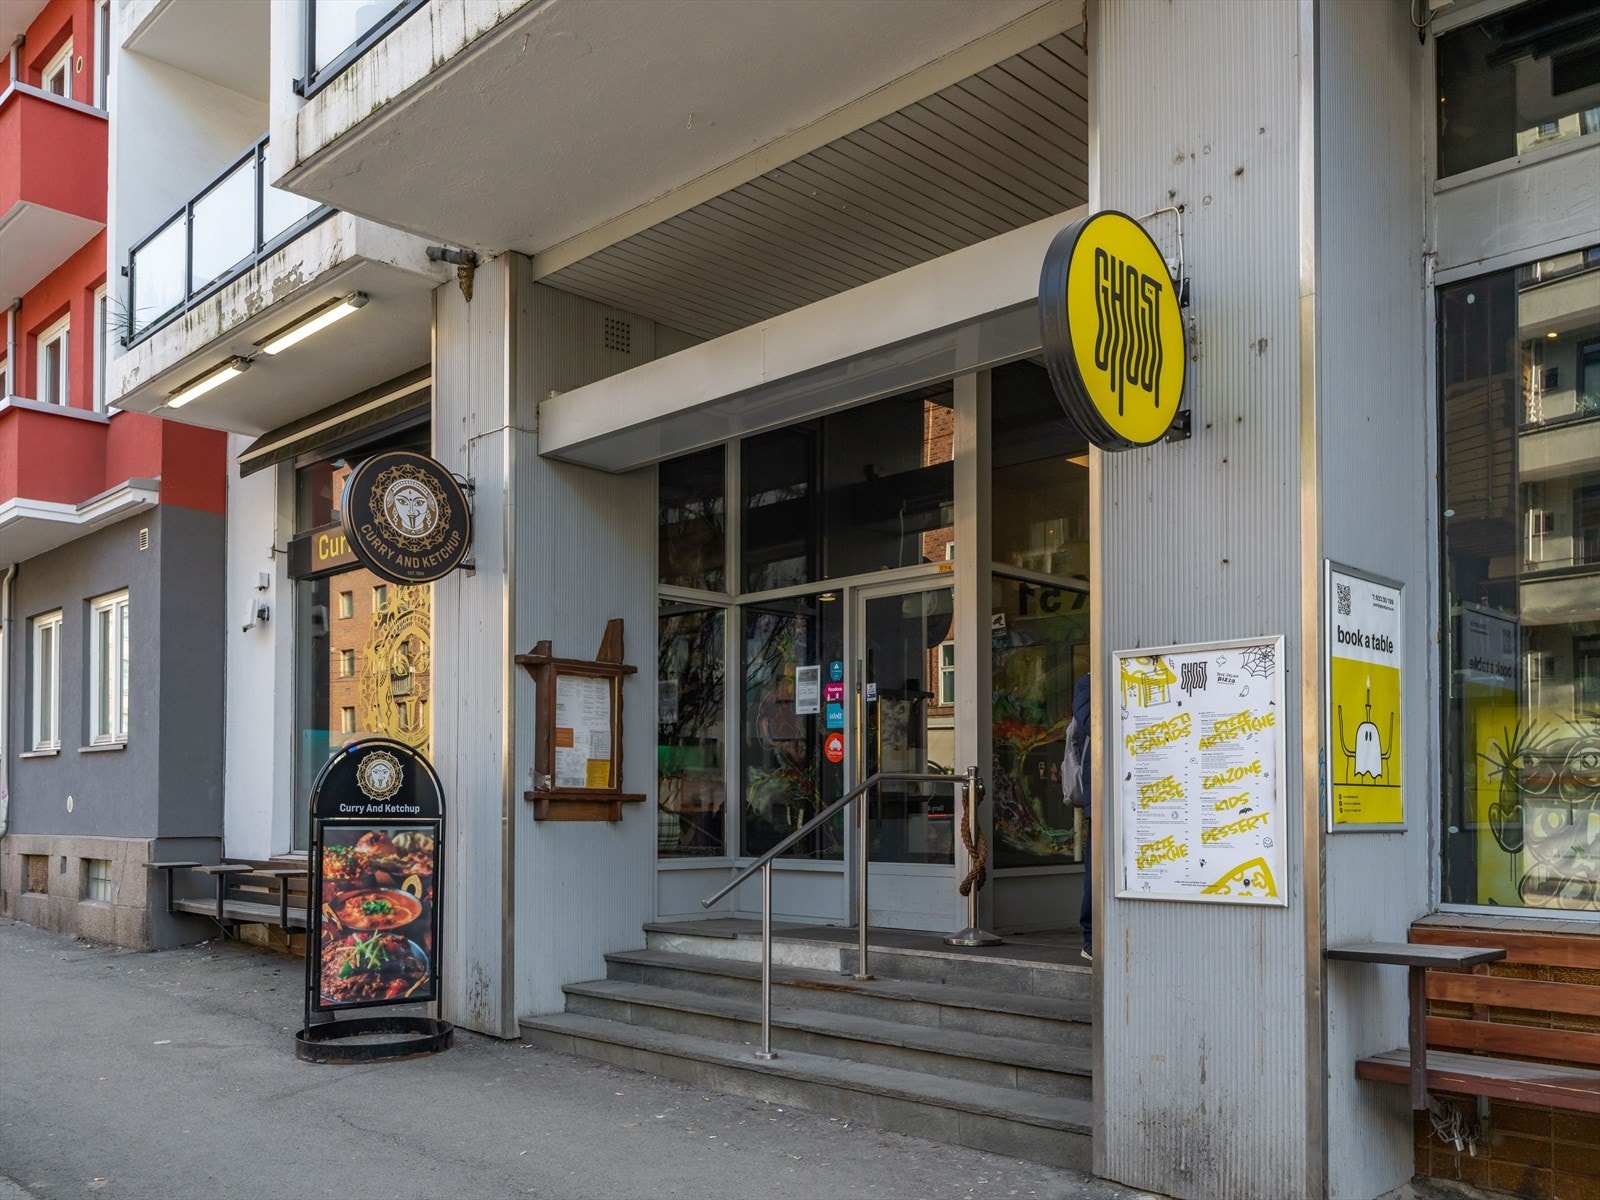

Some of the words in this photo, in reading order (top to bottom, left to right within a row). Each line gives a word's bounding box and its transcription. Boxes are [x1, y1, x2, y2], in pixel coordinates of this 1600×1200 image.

[1094, 247, 1163, 416] GHOST
[319, 534, 351, 560] Cur
[361, 524, 395, 560] CURRY
[395, 554, 420, 568] AND
[422, 530, 461, 568] KETCHUP
[1337, 625, 1363, 648] book
[1365, 635, 1371, 648] a
[1371, 634, 1393, 653] table
[1181, 661, 1208, 697] GHOST
[1203, 760, 1262, 790] CALZONE
[340, 803, 364, 814] Curry
[366, 803, 383, 813] And
[385, 804, 420, 814] Ketchup
[1214, 792, 1250, 811] KIDS
[1201, 812, 1270, 843] DESSERT
